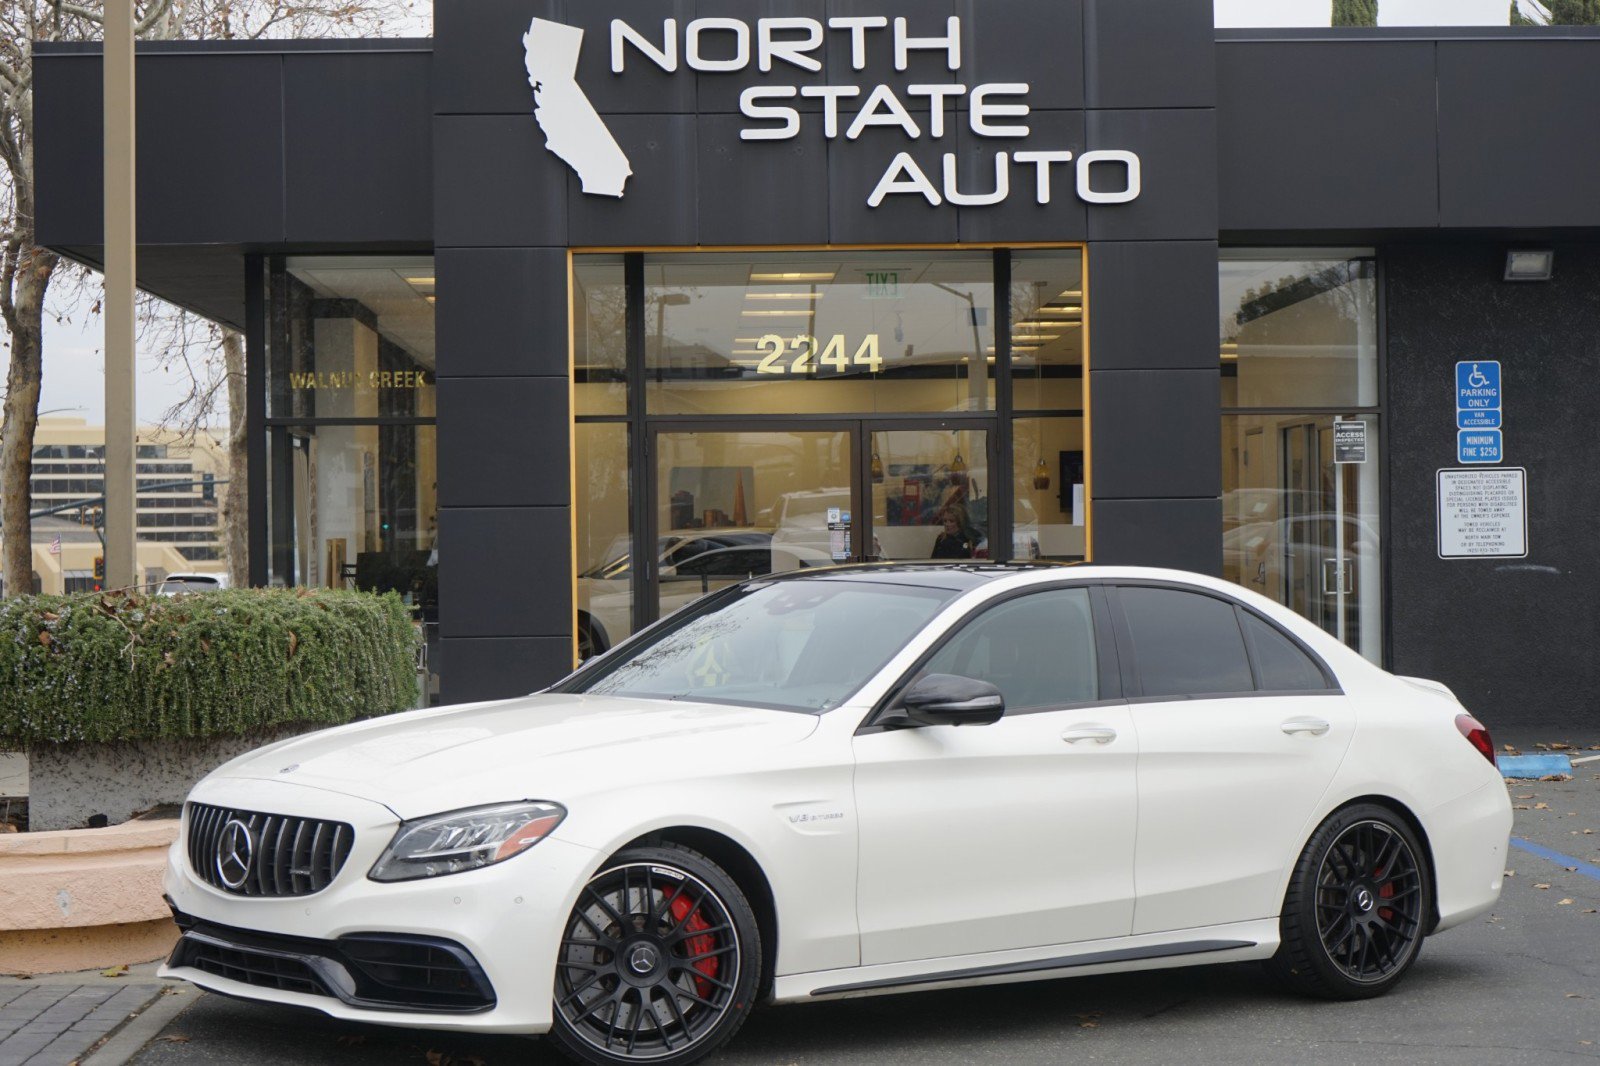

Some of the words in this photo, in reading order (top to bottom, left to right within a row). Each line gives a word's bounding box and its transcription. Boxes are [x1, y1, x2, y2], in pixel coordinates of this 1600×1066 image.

[610, 15, 960, 73] NORTH
[739, 83, 1030, 140] STATE
[867, 150, 1140, 207] AUTO
[756, 333, 883, 374] 2244
[369, 371, 426, 388] CREEK
[1460, 388, 1497, 396] PARKING
[1468, 399, 1490, 407] ONLY
[1466, 436, 1494, 444] MINIMUM
[1463, 448, 1477, 456] FINE
[1480, 447, 1498, 457] $250
